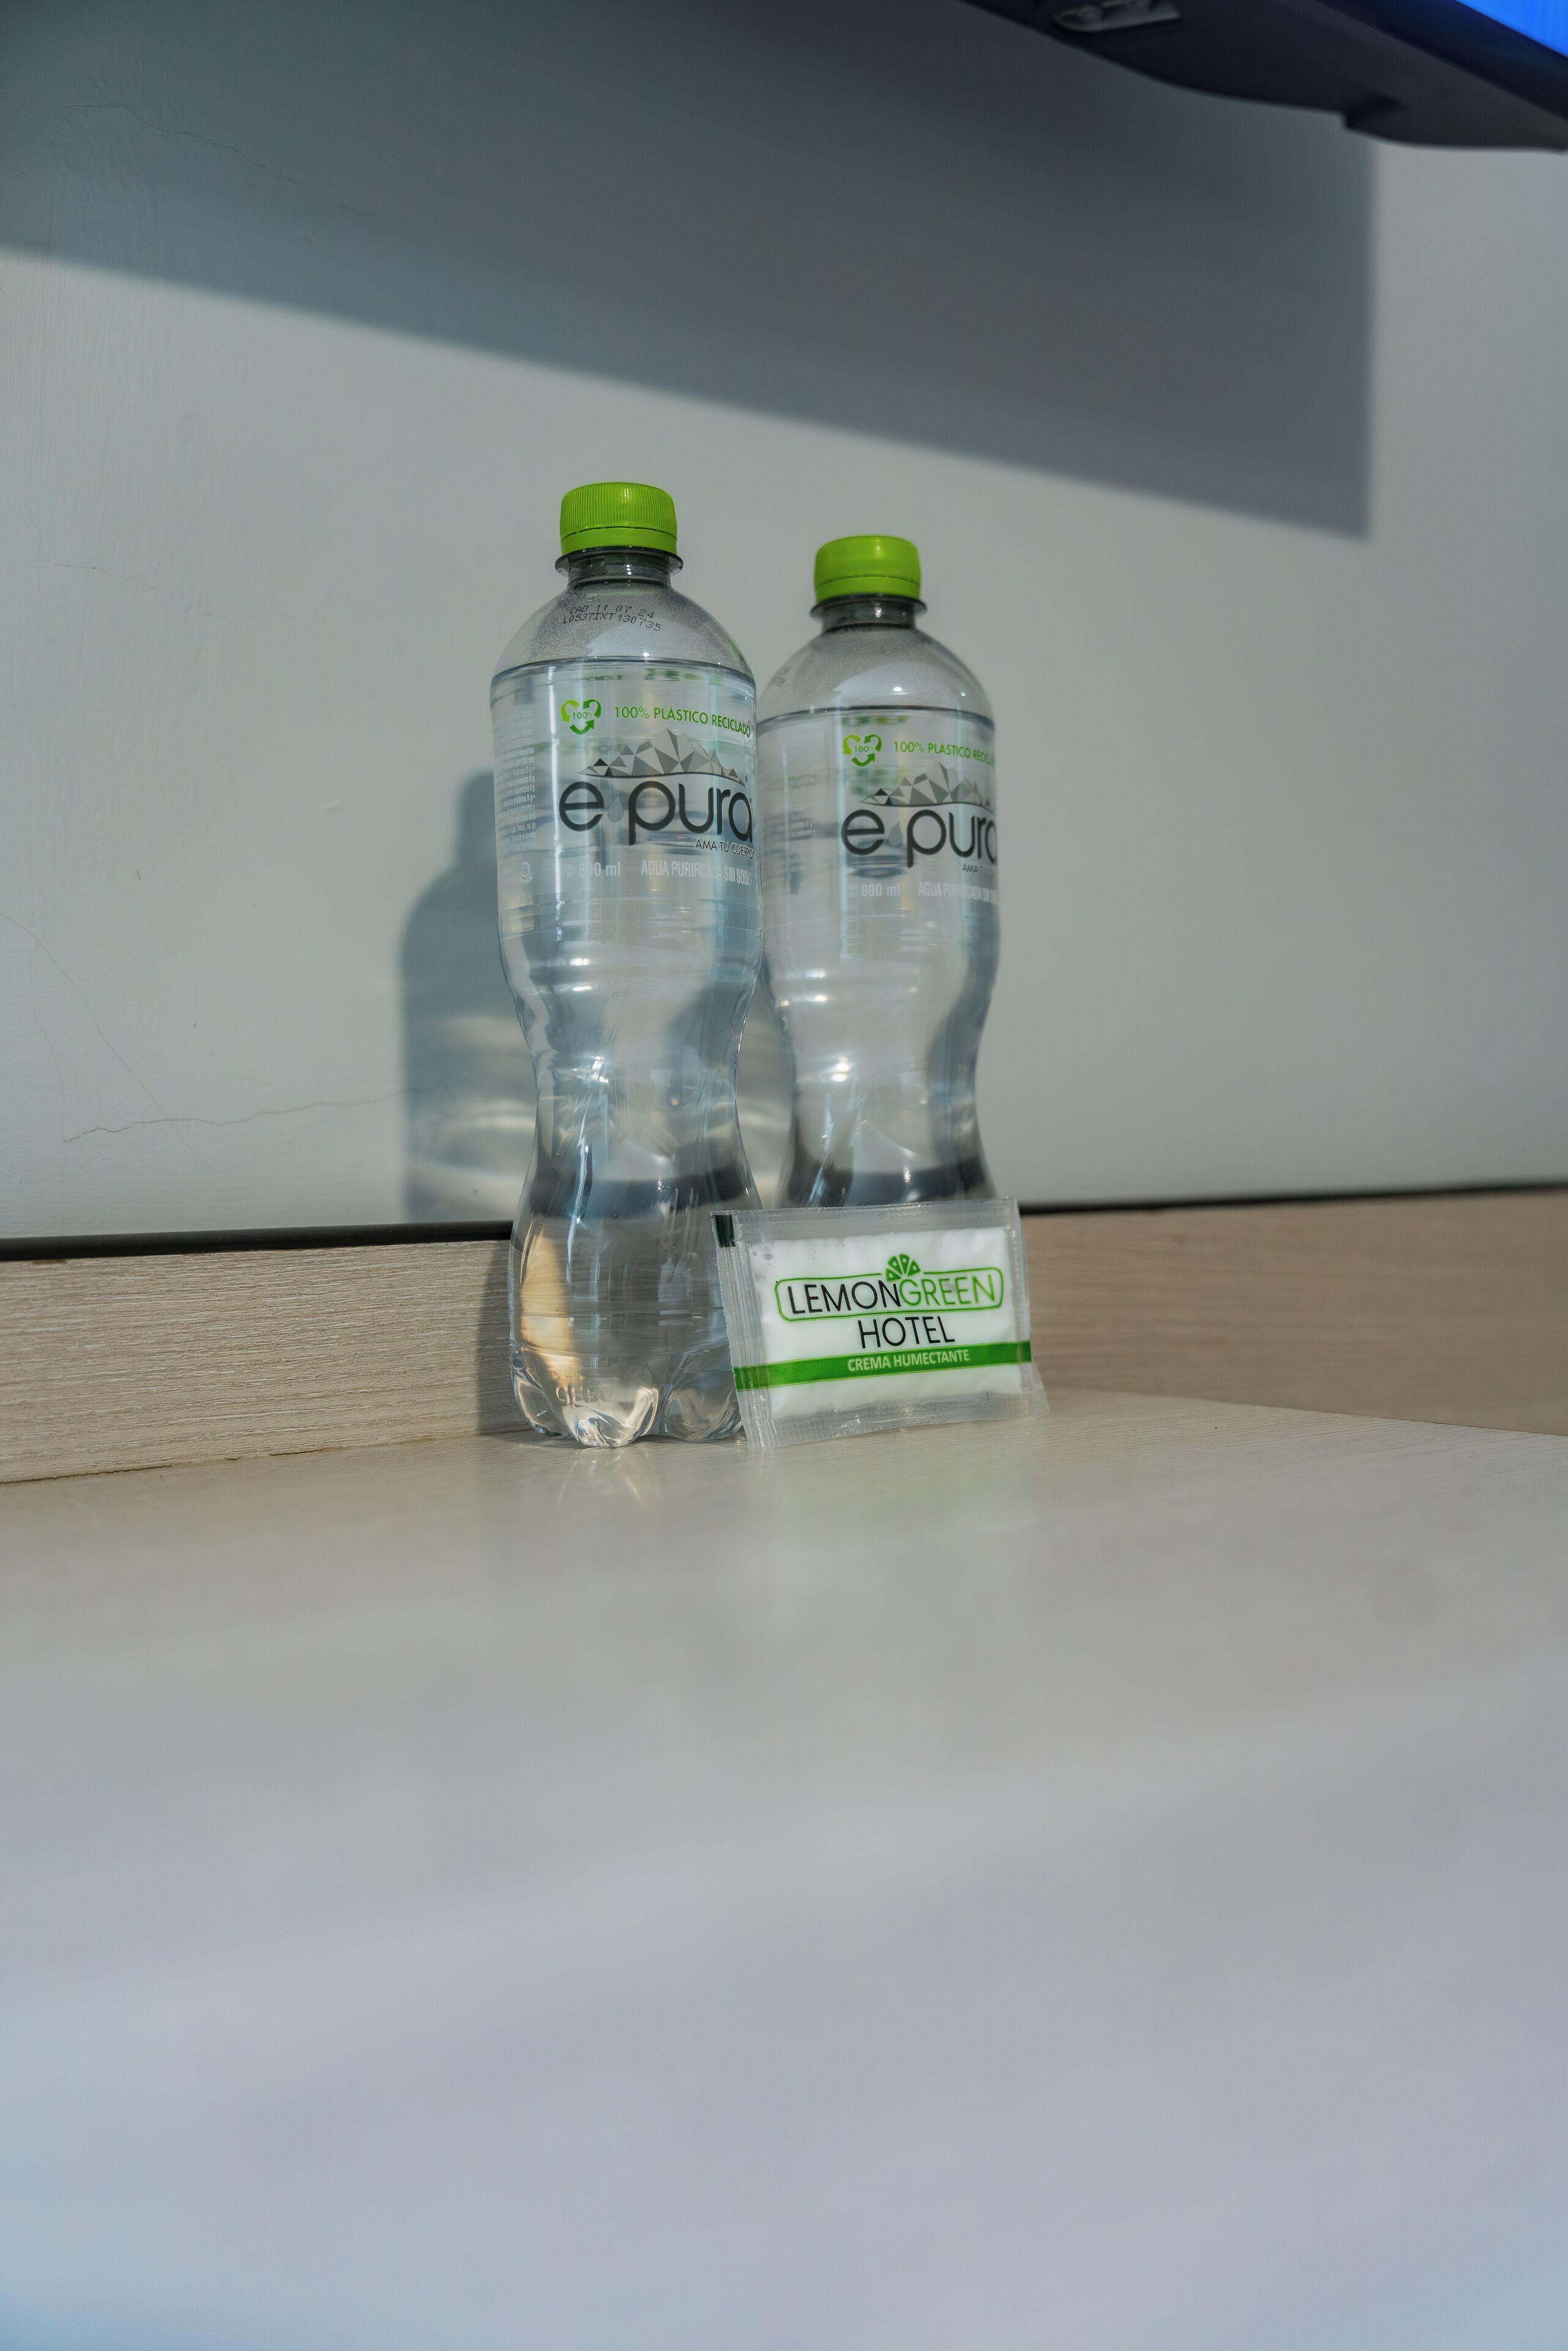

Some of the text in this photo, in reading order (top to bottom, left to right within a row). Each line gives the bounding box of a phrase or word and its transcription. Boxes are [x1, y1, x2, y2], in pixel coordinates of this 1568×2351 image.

[569, 605, 588, 614] CAD
[638, 609, 655, 619] 24
[615, 705, 751, 738] 100% PLÁSTICO RECICLADO
[894, 741, 924, 754] 100%
[928, 741, 970, 759] PLÁSTICO
[695, 839, 718, 851] AMA
[719, 841, 729, 853] TU
[605, 862, 621, 876] ml
[642, 860, 669, 877] AGUA
[671, 861, 722, 879] PURIFICADA
[724, 866, 735, 883] SIN
[861, 883, 882, 898] 600
[887, 883, 901, 897] ml
[918, 882, 943, 898] AGUA
[858, 1316, 955, 1349] HOTEL
[847, 1349, 970, 1372] CREMA HUMECTANTE
